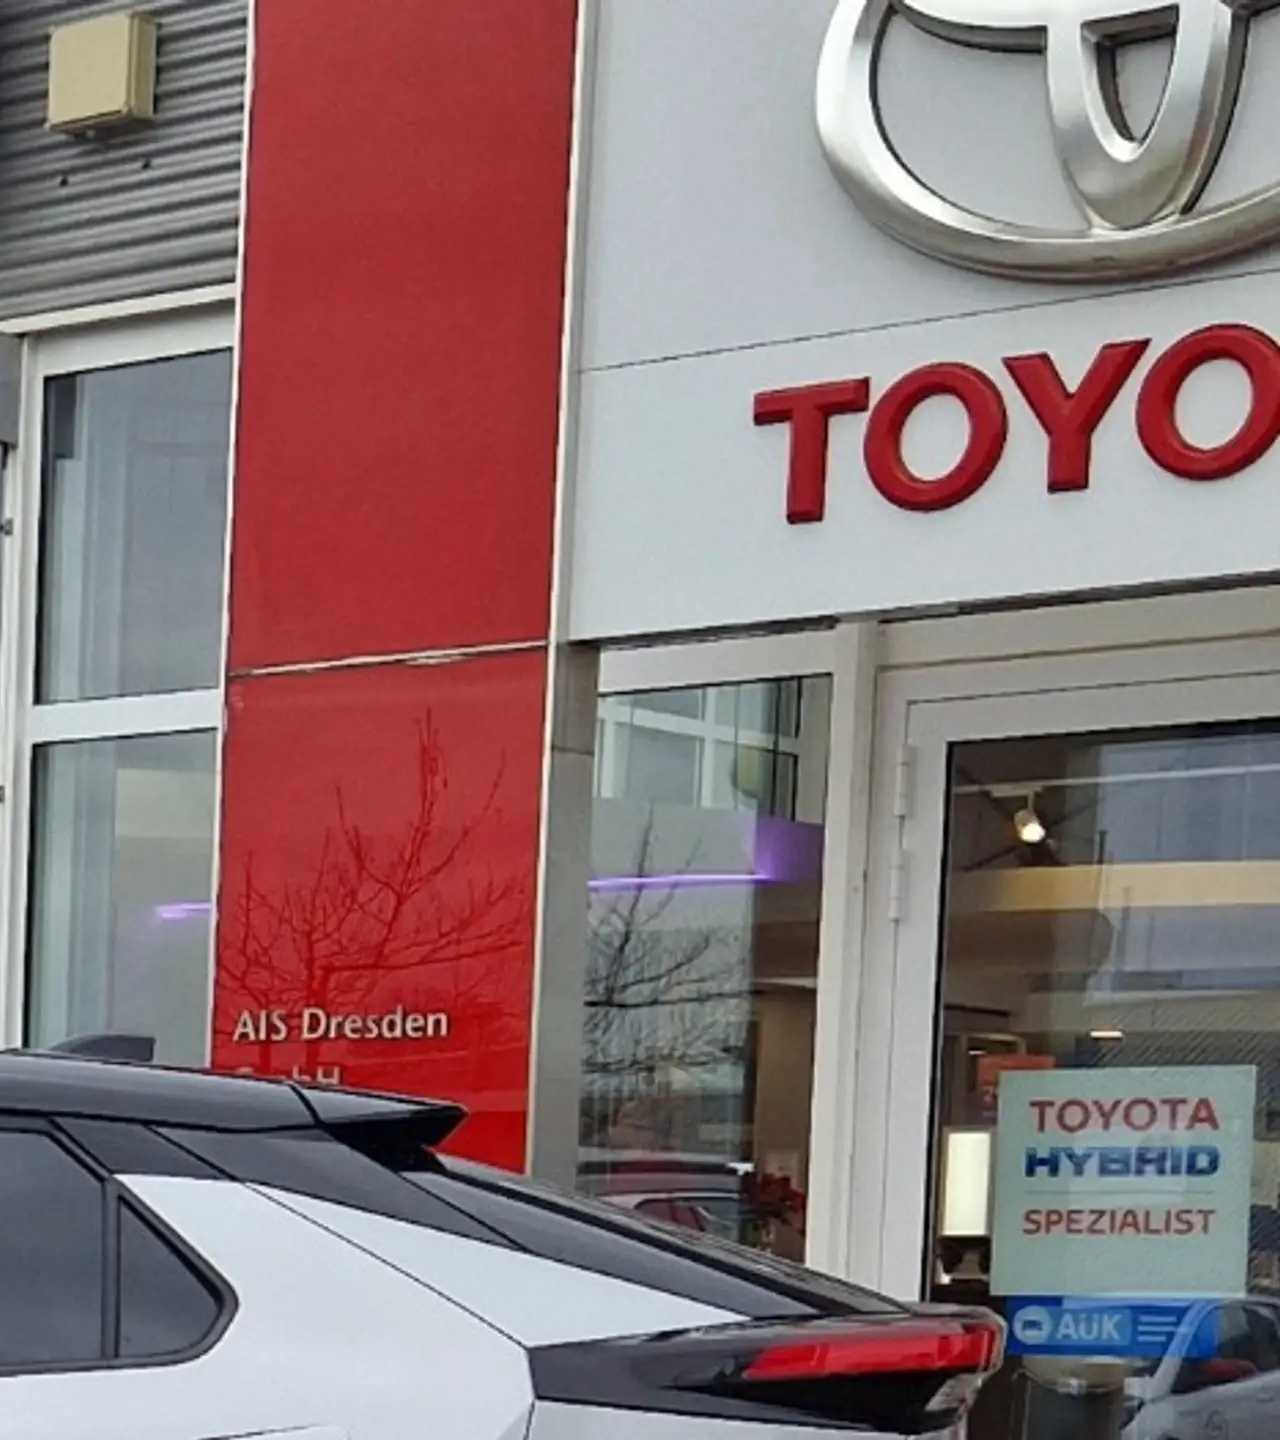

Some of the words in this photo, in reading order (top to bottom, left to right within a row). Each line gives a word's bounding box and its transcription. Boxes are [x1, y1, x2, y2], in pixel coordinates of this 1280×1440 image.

[232, 1010, 288, 1042] AIS
[301, 1004, 450, 1040] Dresden
[1029, 1097, 1221, 1134] TOYOTA
[1024, 1144, 1221, 1178] HYBRID
[1022, 1208, 1216, 1236] SPEZIALIST
